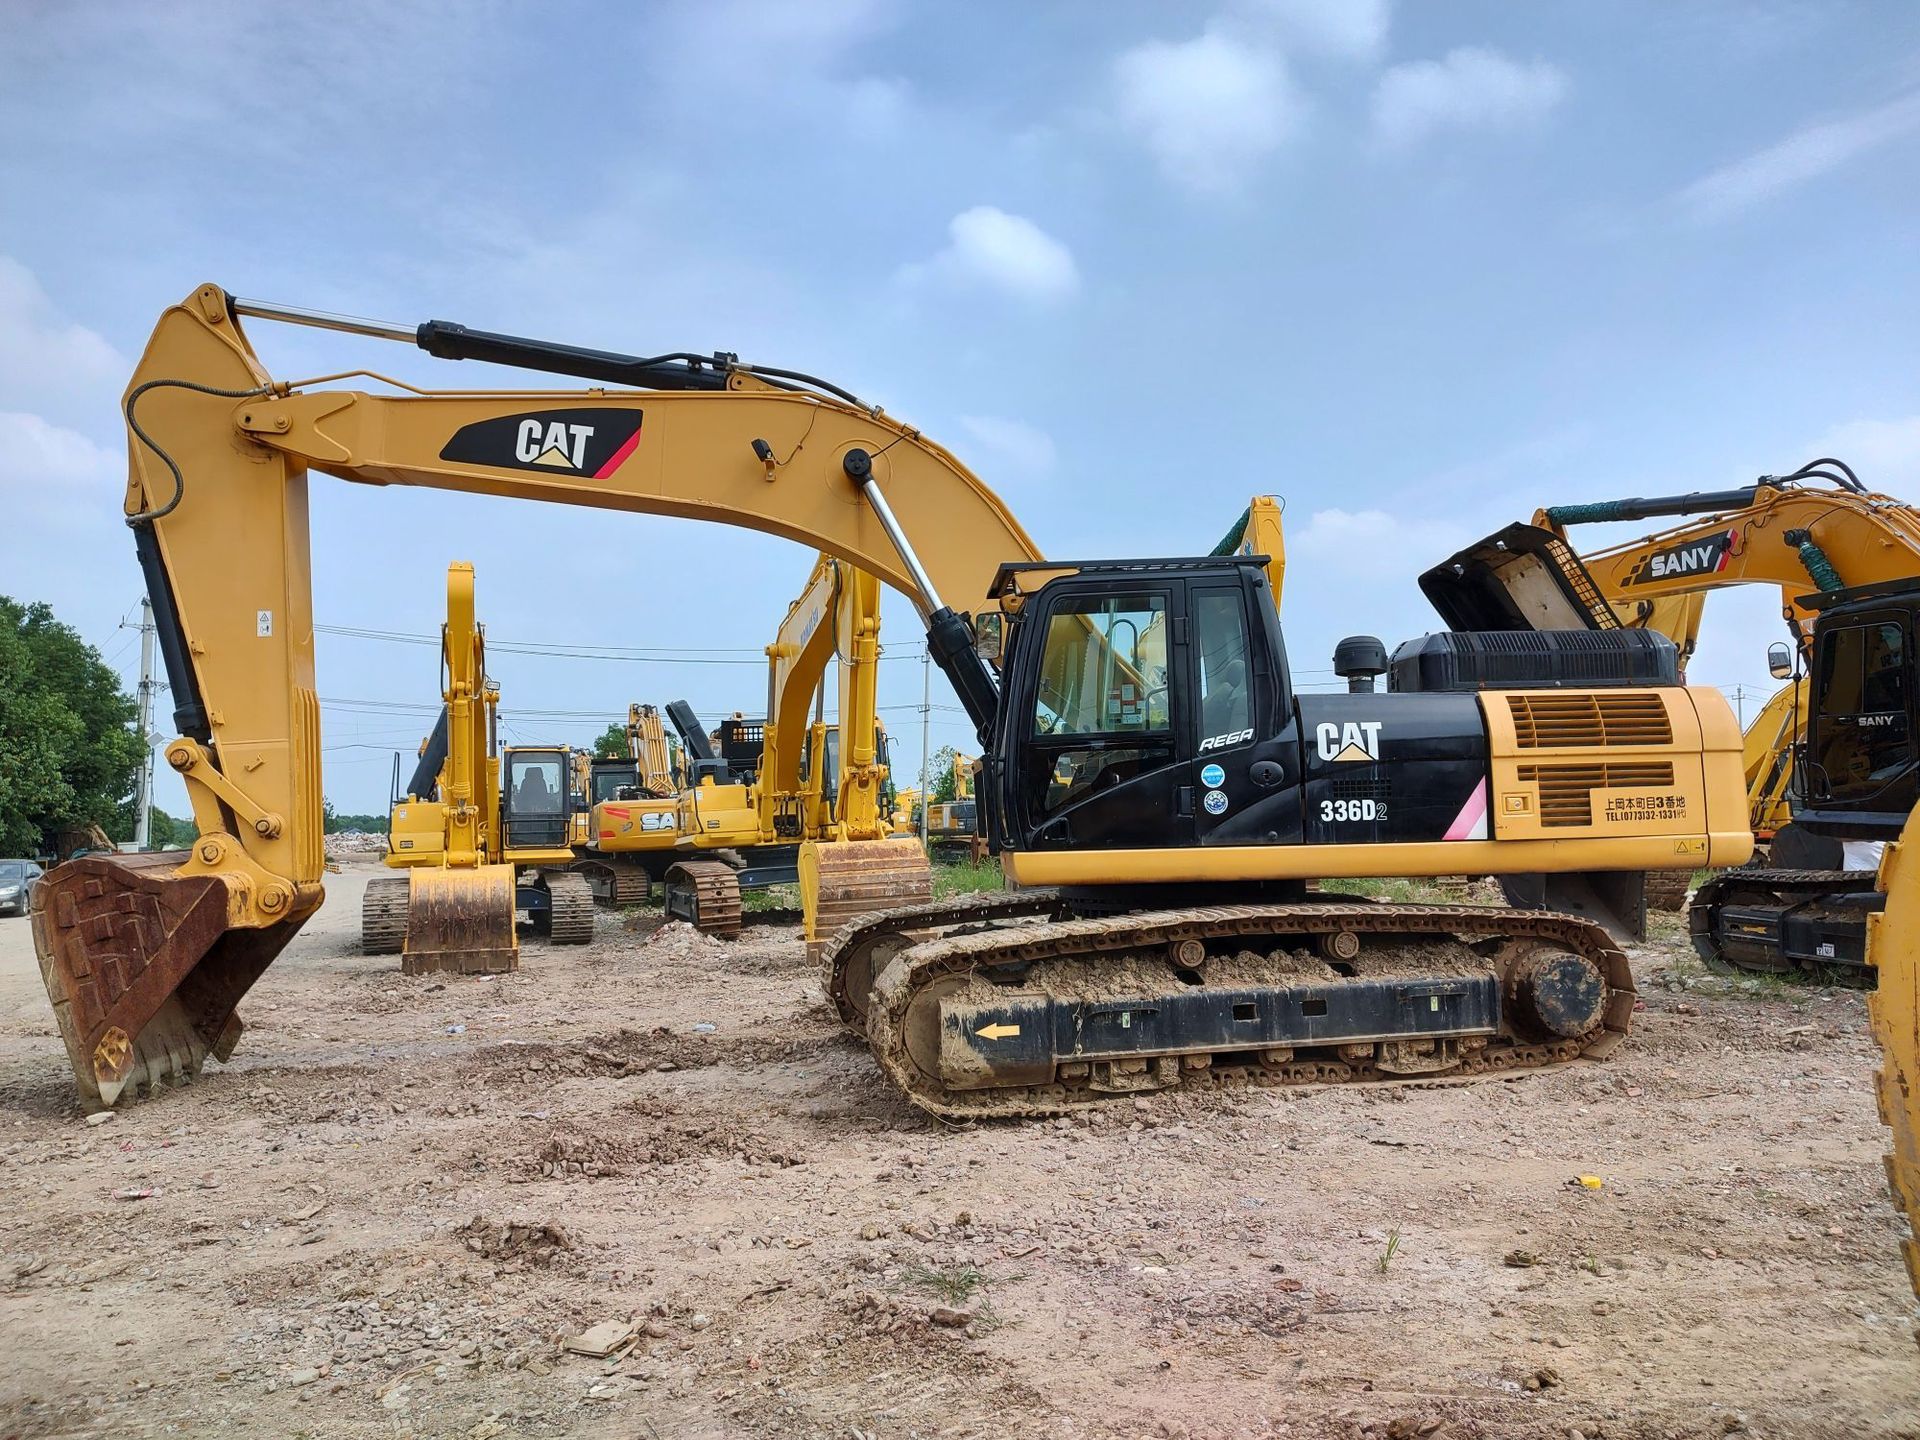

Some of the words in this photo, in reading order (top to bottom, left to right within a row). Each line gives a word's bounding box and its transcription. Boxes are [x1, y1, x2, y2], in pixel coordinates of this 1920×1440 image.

[515, 419, 595, 469] CAT
[1651, 545, 1713, 577] SANY
[1858, 715, 1893, 726] SANY
[1199, 728, 1254, 752] REGA
[1316, 721, 1382, 762] CAT
[641, 812, 675, 832] SA
[1320, 799, 1388, 822] 336D2
